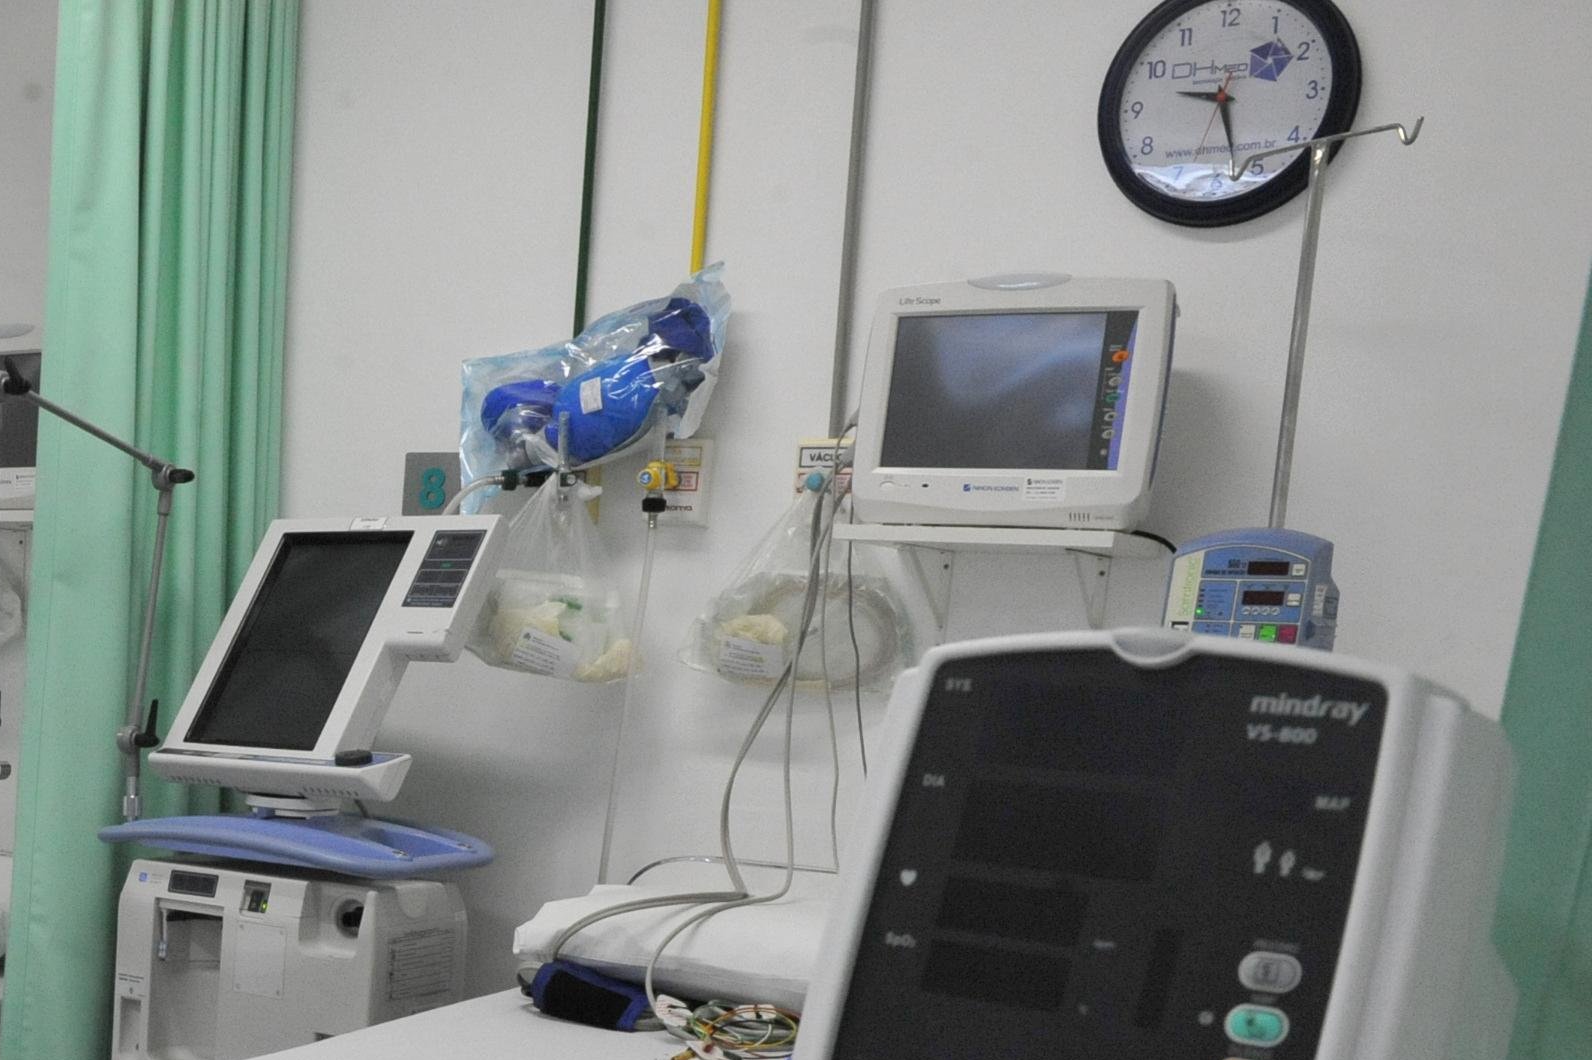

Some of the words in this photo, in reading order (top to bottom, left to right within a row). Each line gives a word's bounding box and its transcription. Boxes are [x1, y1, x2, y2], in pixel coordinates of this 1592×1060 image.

[1221, 8, 1241, 27] 12
[1271, 16, 1279, 34] 1
[1179, 28, 1193, 47] 11
[1296, 42, 1311, 61] 2
[1147, 60, 1166, 79] 10
[1306, 80, 1319, 99] 3
[1131, 102, 1144, 119] 9
[1287, 126, 1301, 143] 4
[1140, 136, 1154, 156] 8
[1173, 166, 1184, 181] 7
[1250, 159, 1264, 176] 5
[1211, 173, 1223, 191] 6
[419, 467, 446, 510] 8
[1250, 692, 1370, 726] mindray
